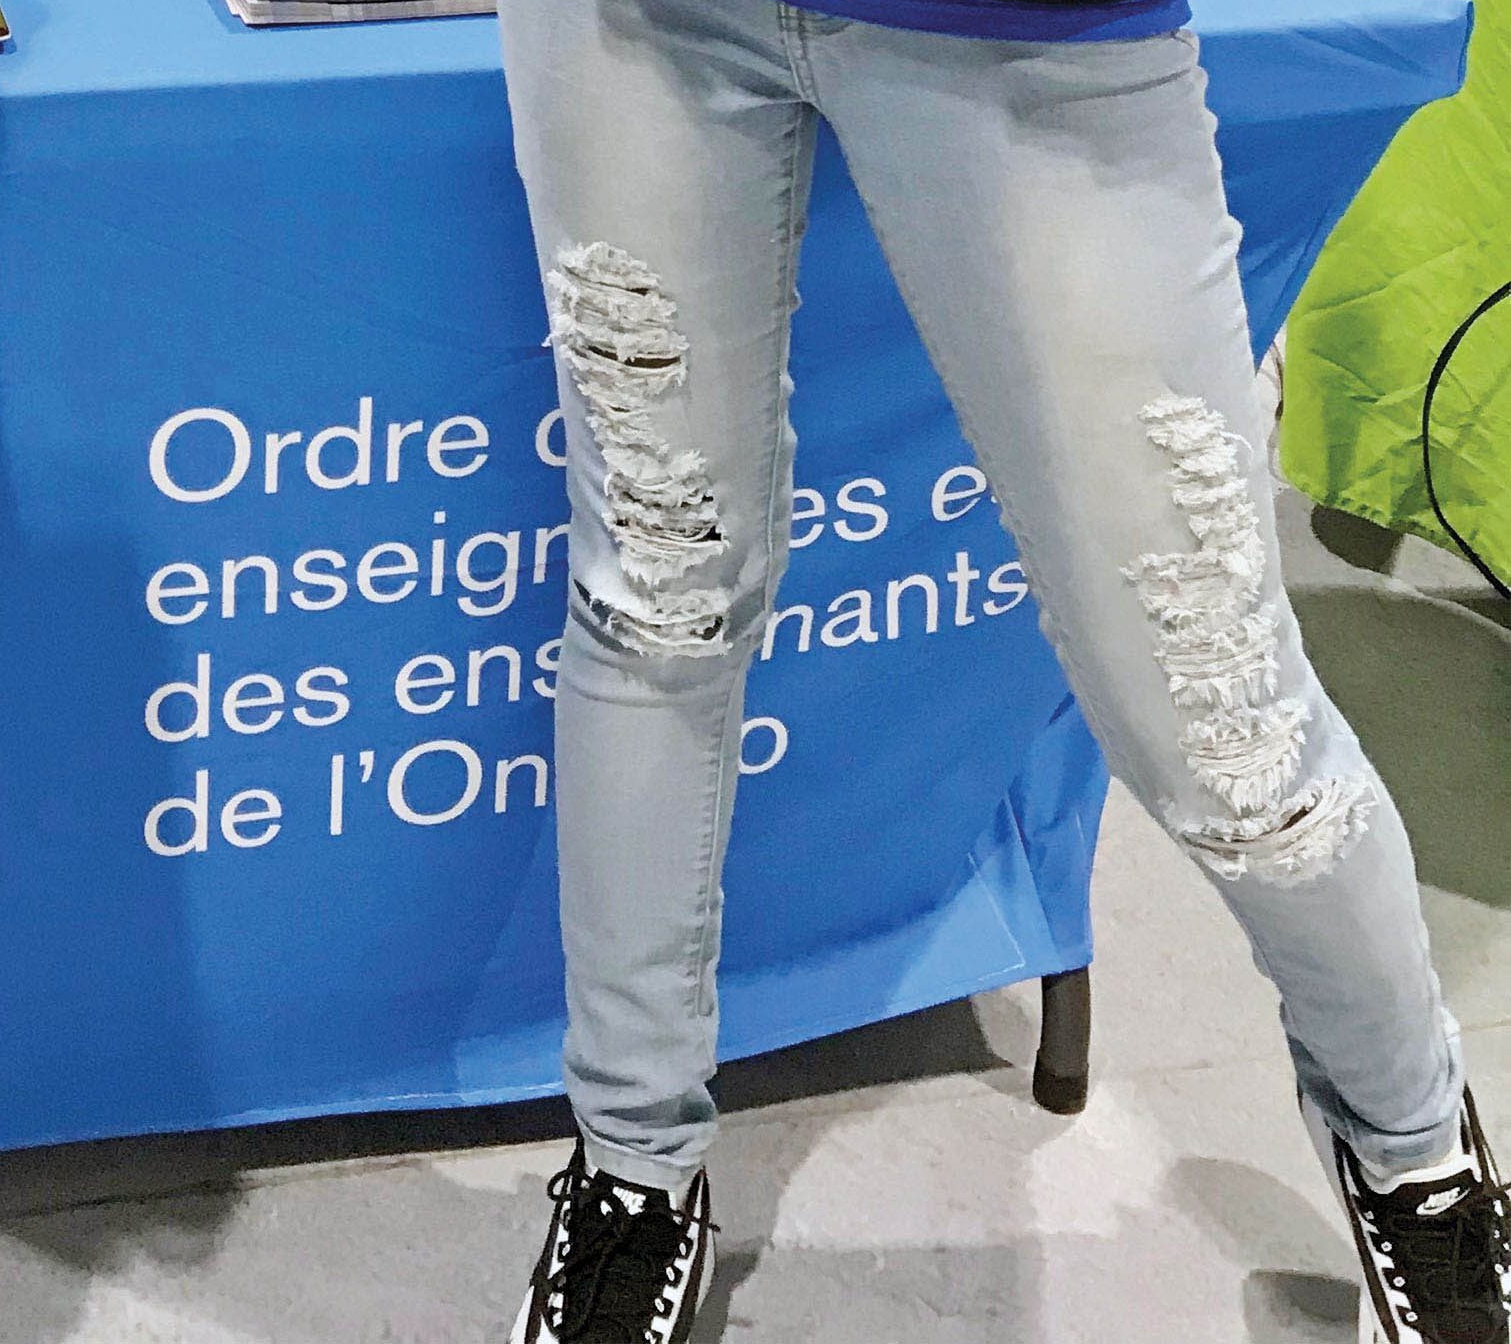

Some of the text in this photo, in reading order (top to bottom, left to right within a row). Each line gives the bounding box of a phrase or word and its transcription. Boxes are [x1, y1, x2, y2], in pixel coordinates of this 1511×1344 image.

[148, 395, 490, 504] Ordre
[144, 651, 350, 744] des
[143, 767, 283, 858] de
